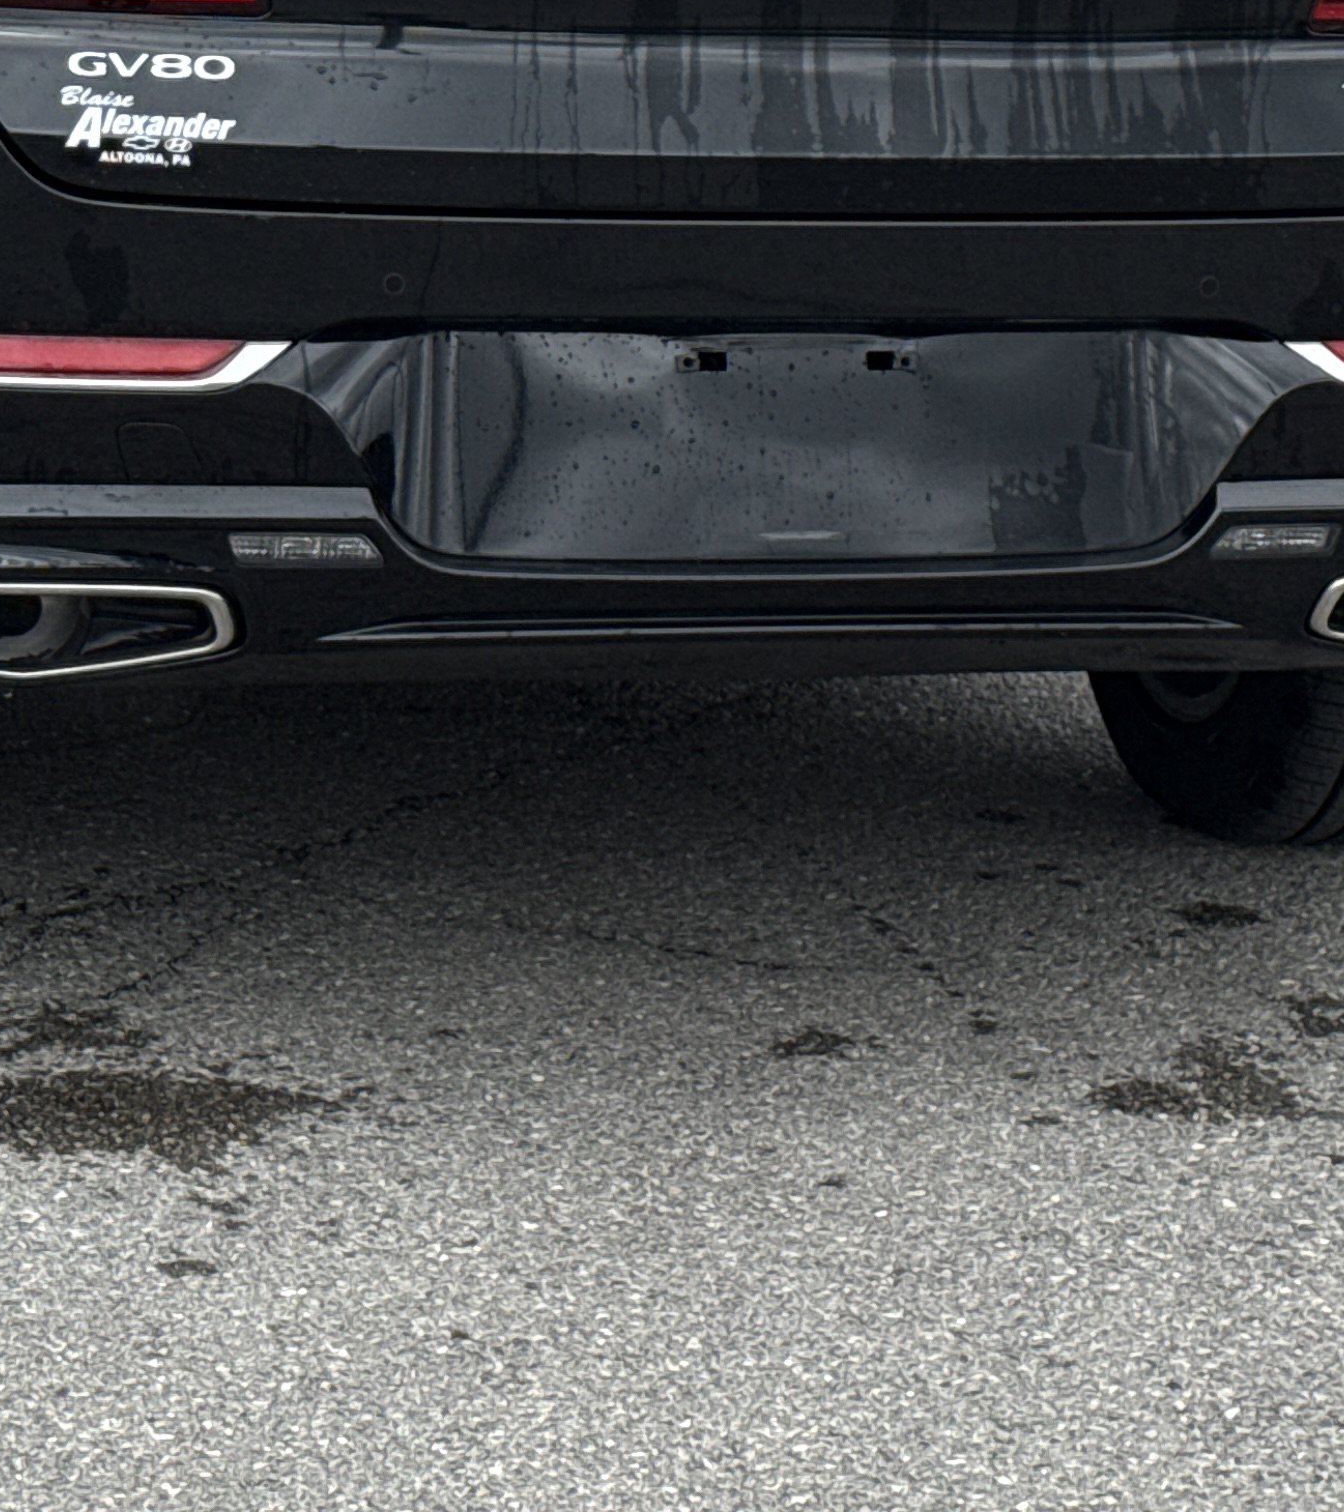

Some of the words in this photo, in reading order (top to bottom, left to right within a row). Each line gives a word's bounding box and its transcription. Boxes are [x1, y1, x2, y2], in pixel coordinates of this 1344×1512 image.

[67, 51, 236, 80] GV80
[60, 85, 135, 107] Blaise
[64, 106, 237, 149] Alexander
[99, 150, 169, 168] ALTOONA,
[172, 153, 192, 167] PA
